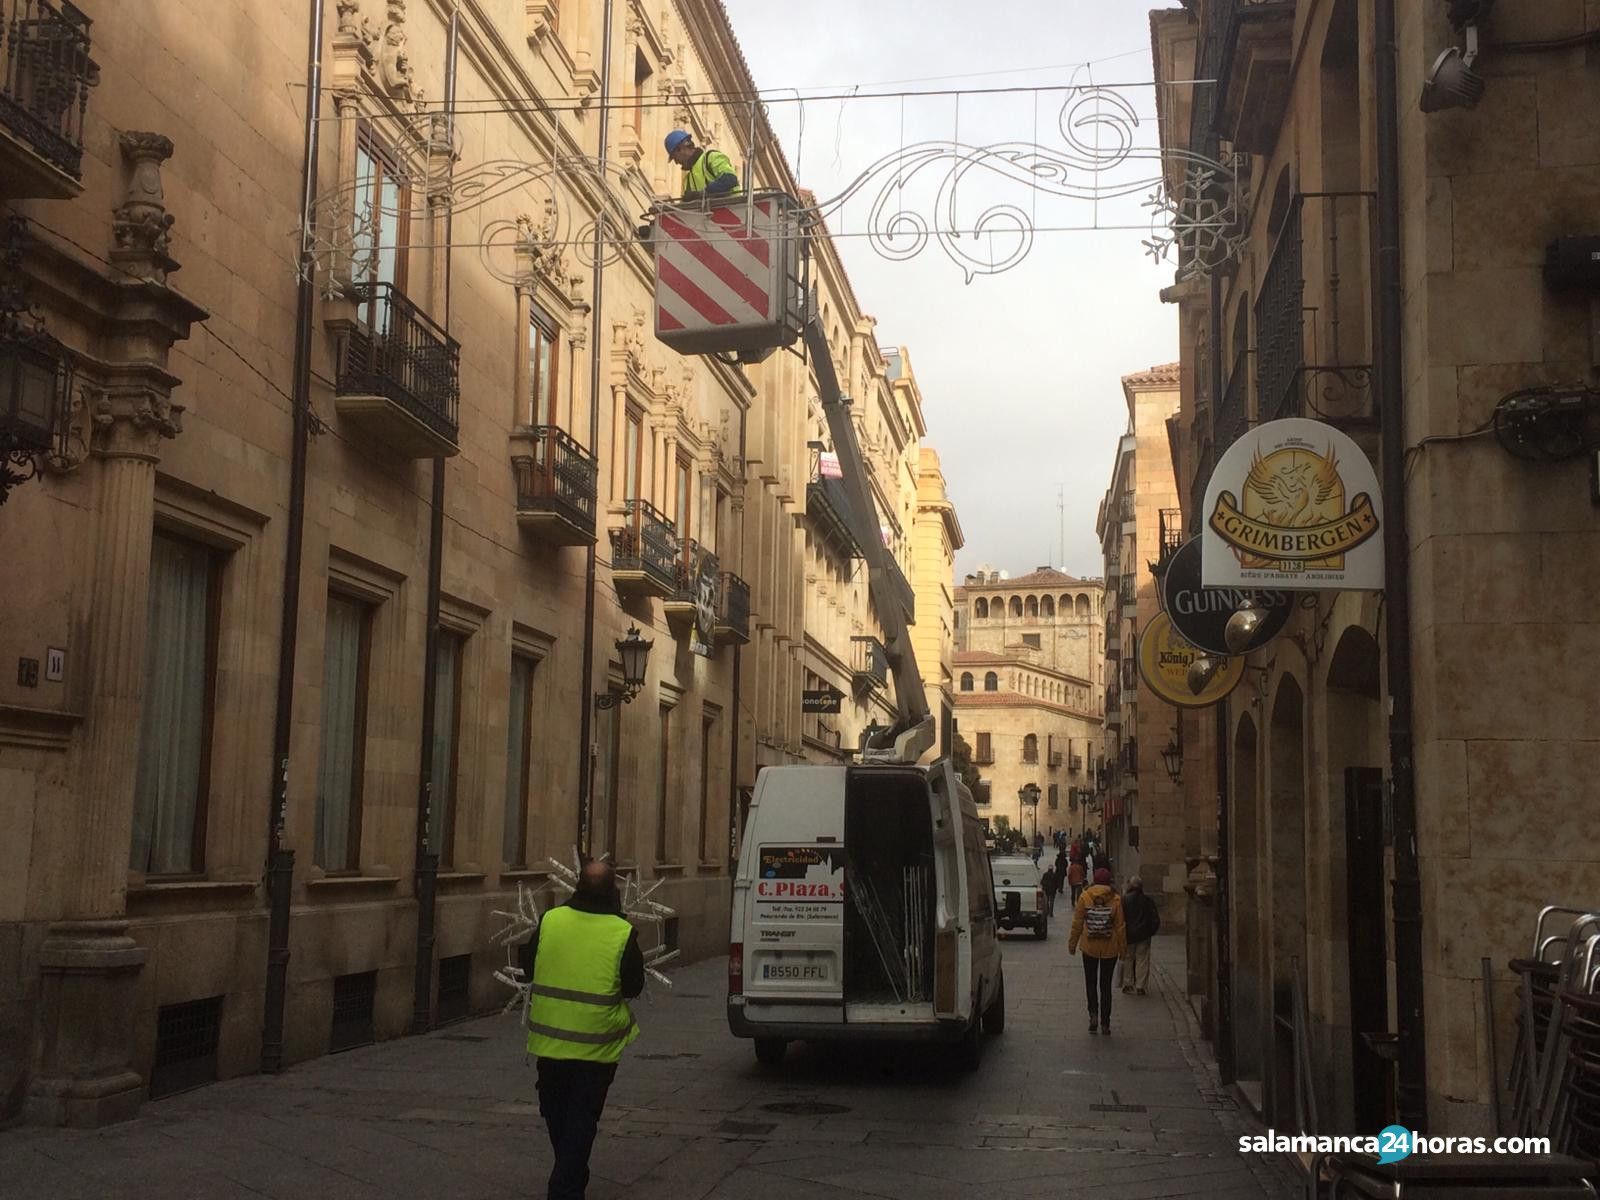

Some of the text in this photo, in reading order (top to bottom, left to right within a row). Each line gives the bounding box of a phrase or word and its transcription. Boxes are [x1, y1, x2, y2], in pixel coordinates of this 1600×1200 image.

[1224, 516, 1363, 551] GRIMBERGEN
[52, 656, 60, 673] 11
[763, 855, 818, 864] Electricidad
[770, 966, 825, 978] 8550 FFL
